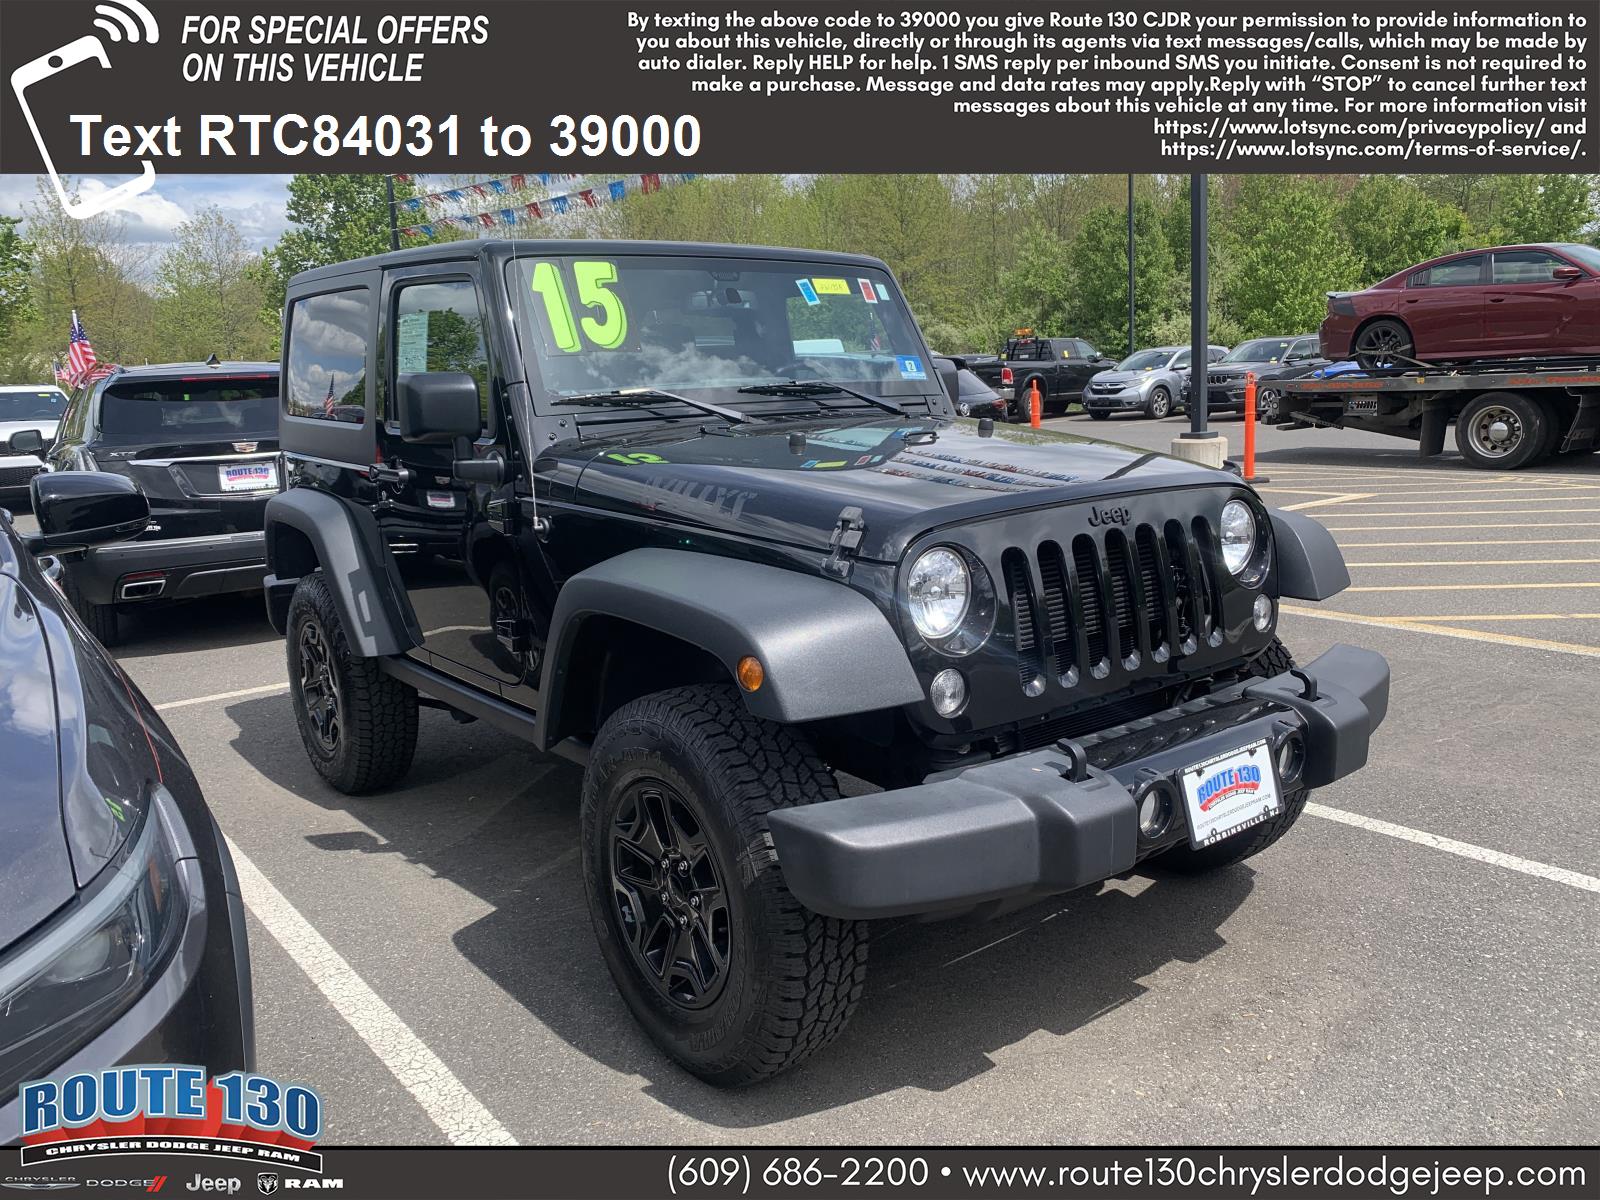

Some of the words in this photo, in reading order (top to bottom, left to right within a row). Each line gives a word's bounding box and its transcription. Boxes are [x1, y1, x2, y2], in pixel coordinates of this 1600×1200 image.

[532, 262, 627, 352] 15
[225, 467, 253, 478] ROUTE
[1088, 506, 1132, 527] Jeep
[1197, 767, 1235, 804] ROUTE
[1237, 765, 1261, 783] 130
[1270, 808, 1280, 818] NJ
